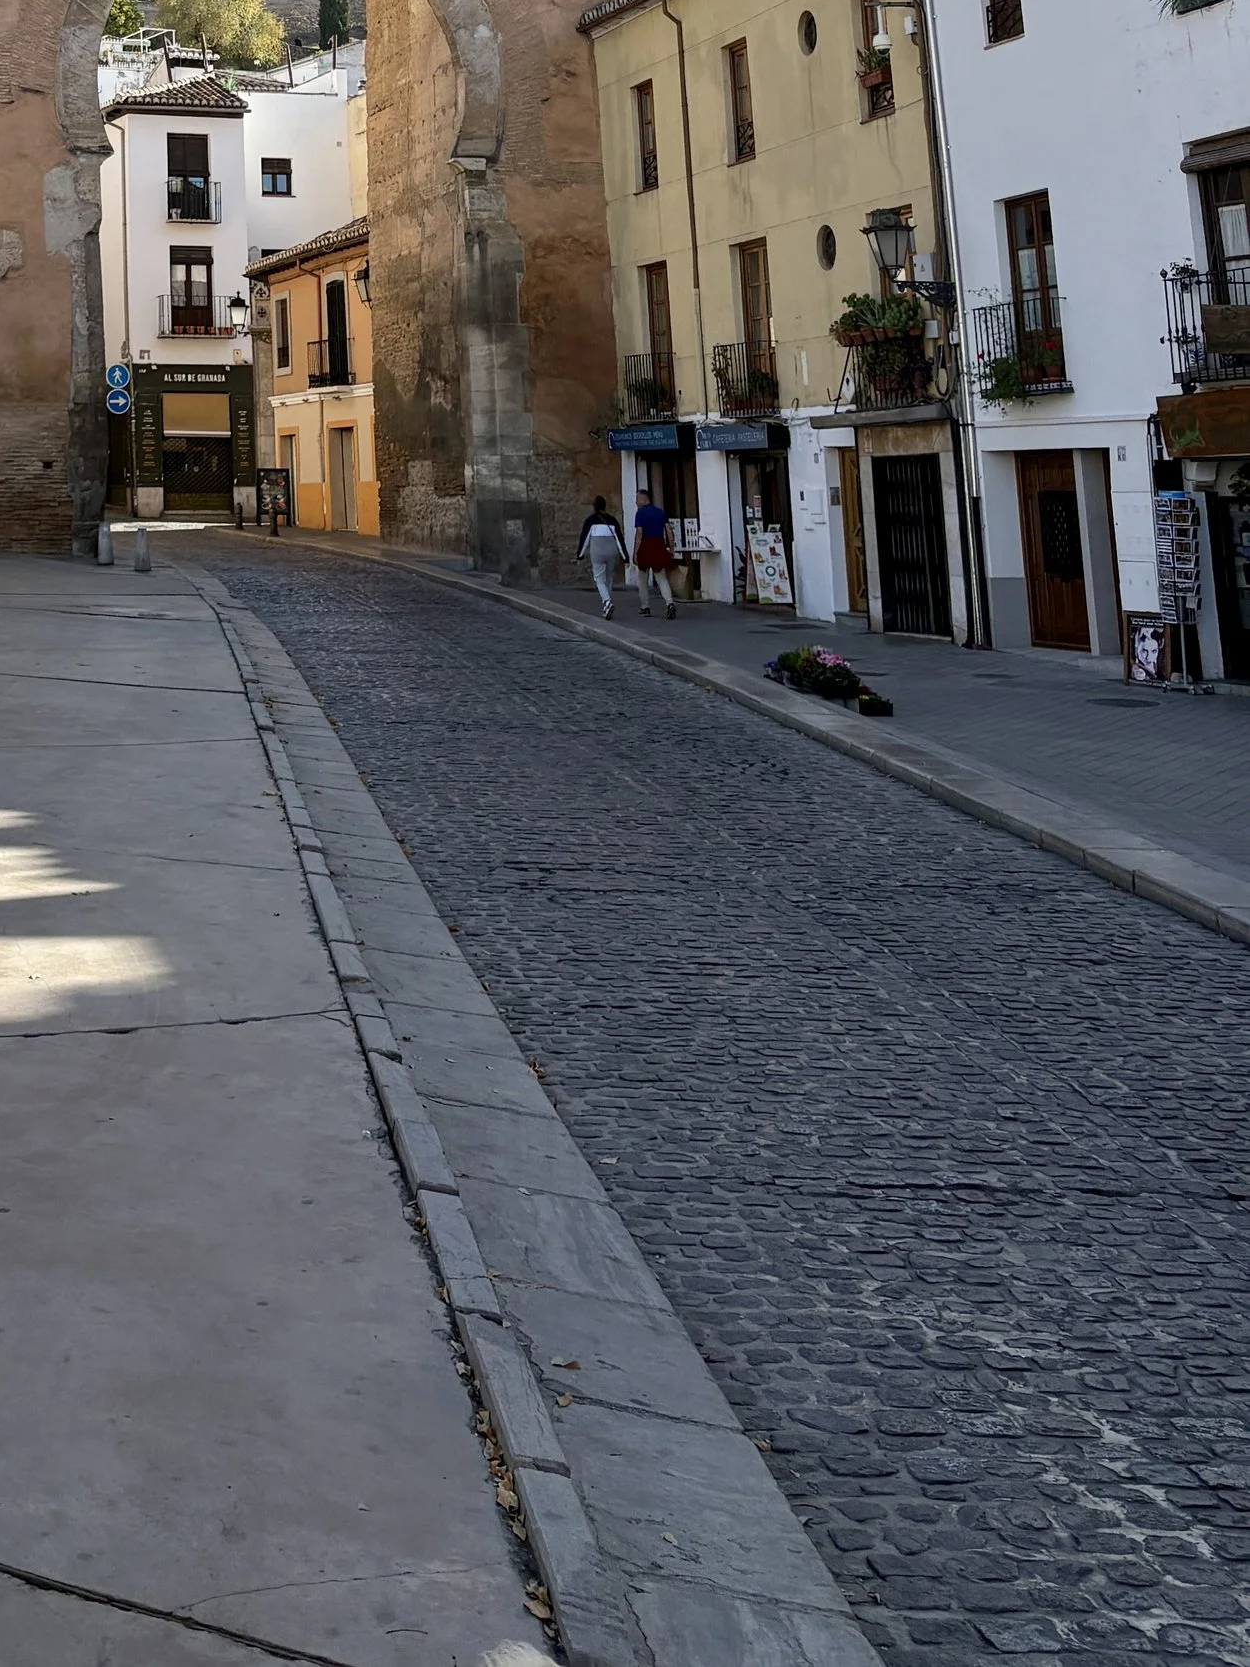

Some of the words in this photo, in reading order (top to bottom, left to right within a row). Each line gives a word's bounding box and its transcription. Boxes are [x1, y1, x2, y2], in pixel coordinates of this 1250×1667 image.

[163, 374, 172, 382] AL
[174, 374, 186, 382] SUR
[187, 374, 196, 382] DE
[197, 374, 226, 382] GRANADA
